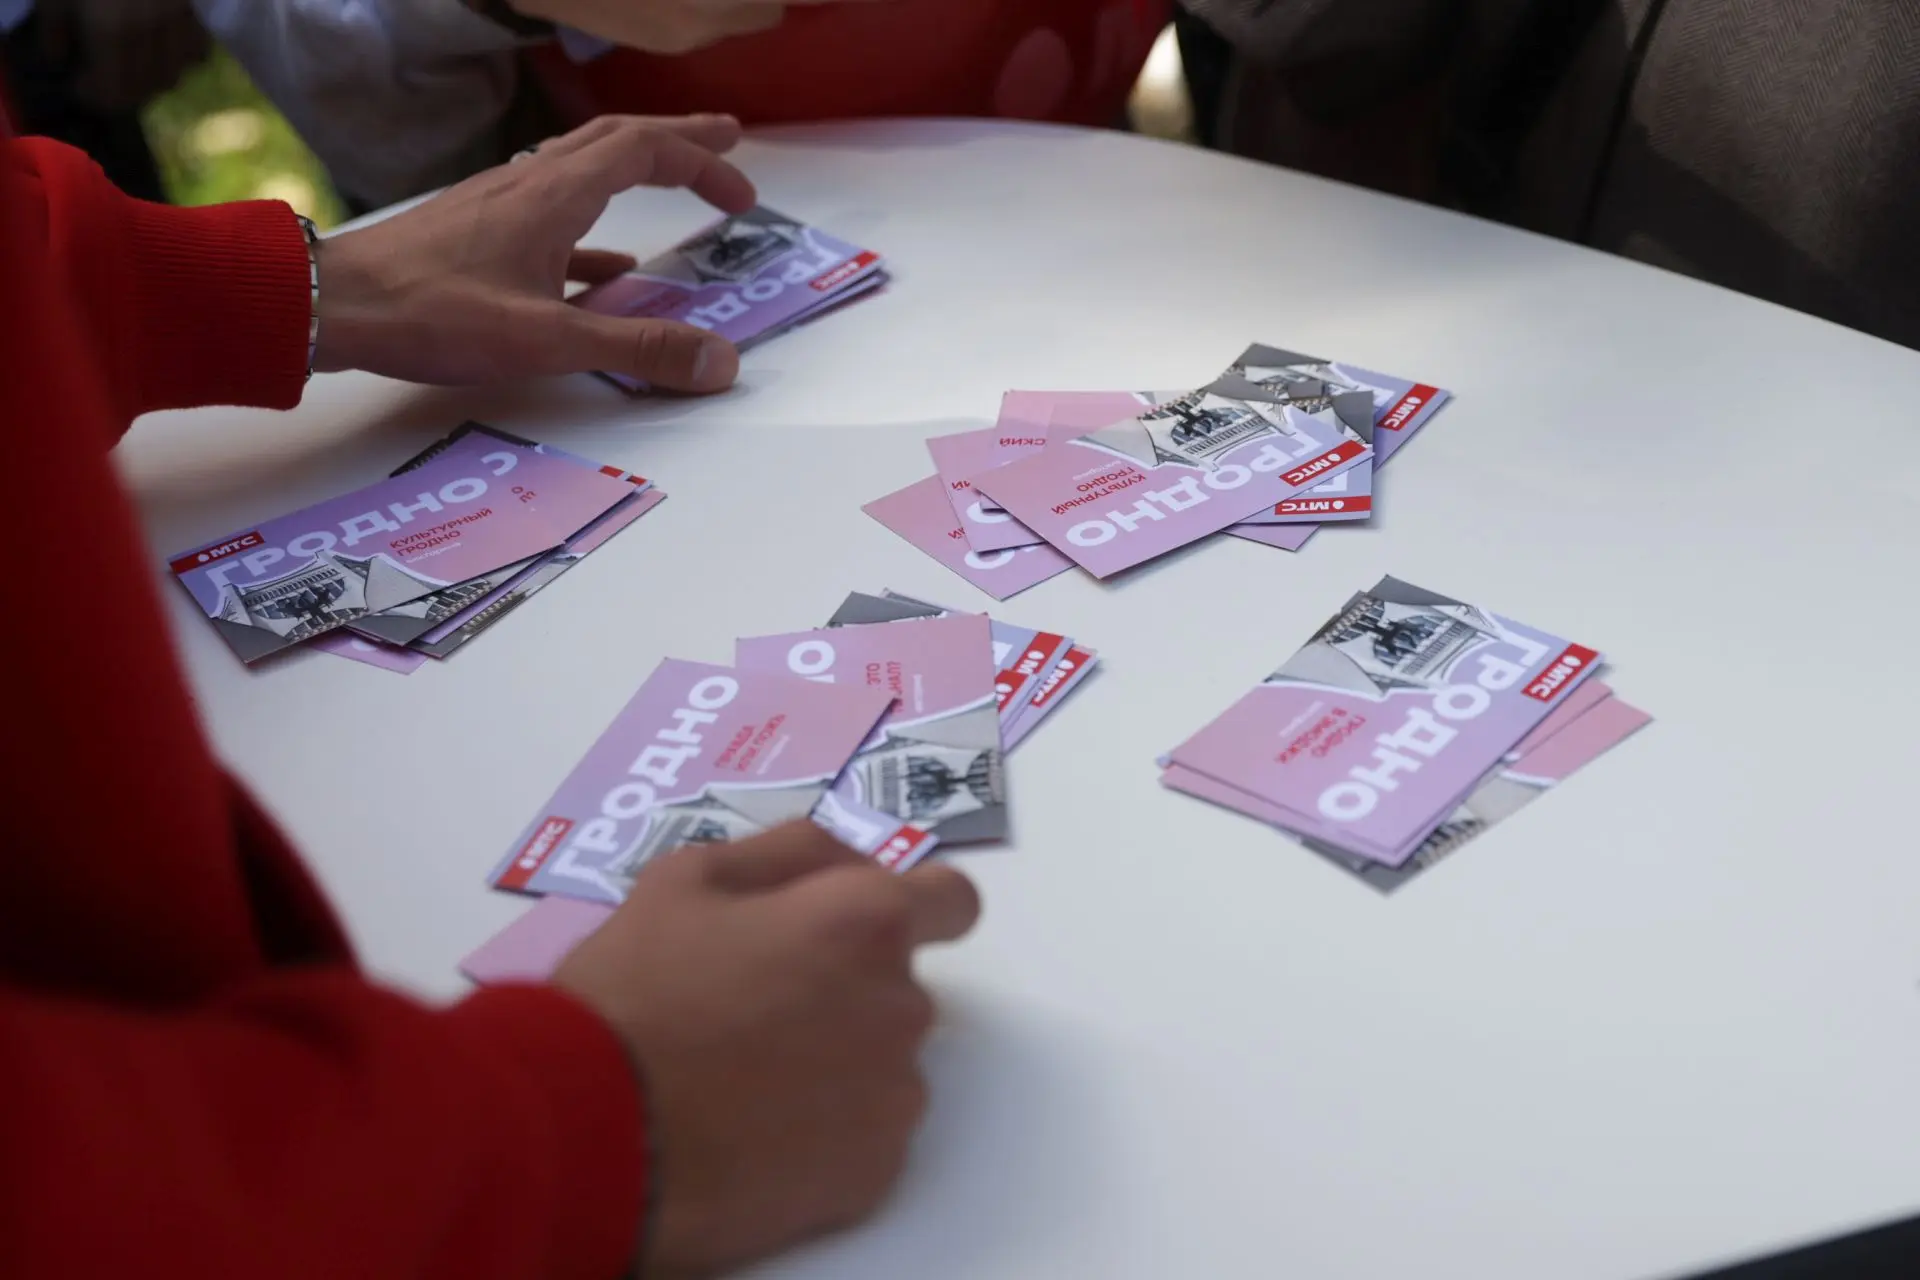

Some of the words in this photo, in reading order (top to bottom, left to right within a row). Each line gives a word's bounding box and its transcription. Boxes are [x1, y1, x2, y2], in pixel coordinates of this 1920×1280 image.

[684, 229, 841, 330] ГРОД
[1384, 400, 1417, 428] МТС
[999, 437, 1047, 447] СКИЙ
[1065, 406, 1322, 546] ГРОДНО
[1076, 466, 1136, 492] ГРОДНО
[1287, 456, 1332, 483] МТС
[1051, 473, 1146, 515] КУЛЬТУРНЫЙ
[1281, 500, 1330, 512] МТС
[206, 477, 488, 590] ГРОДНО
[390, 507, 493, 550] КУЛЬТУРНЫЙ
[396, 530, 461, 557] ГРОДНО
[209, 535, 257, 558] МТС
[1530, 663, 1573, 698] МТС
[1316, 625, 1550, 822] ГРОДНО
[549, 675, 739, 895] ГРОДНО
